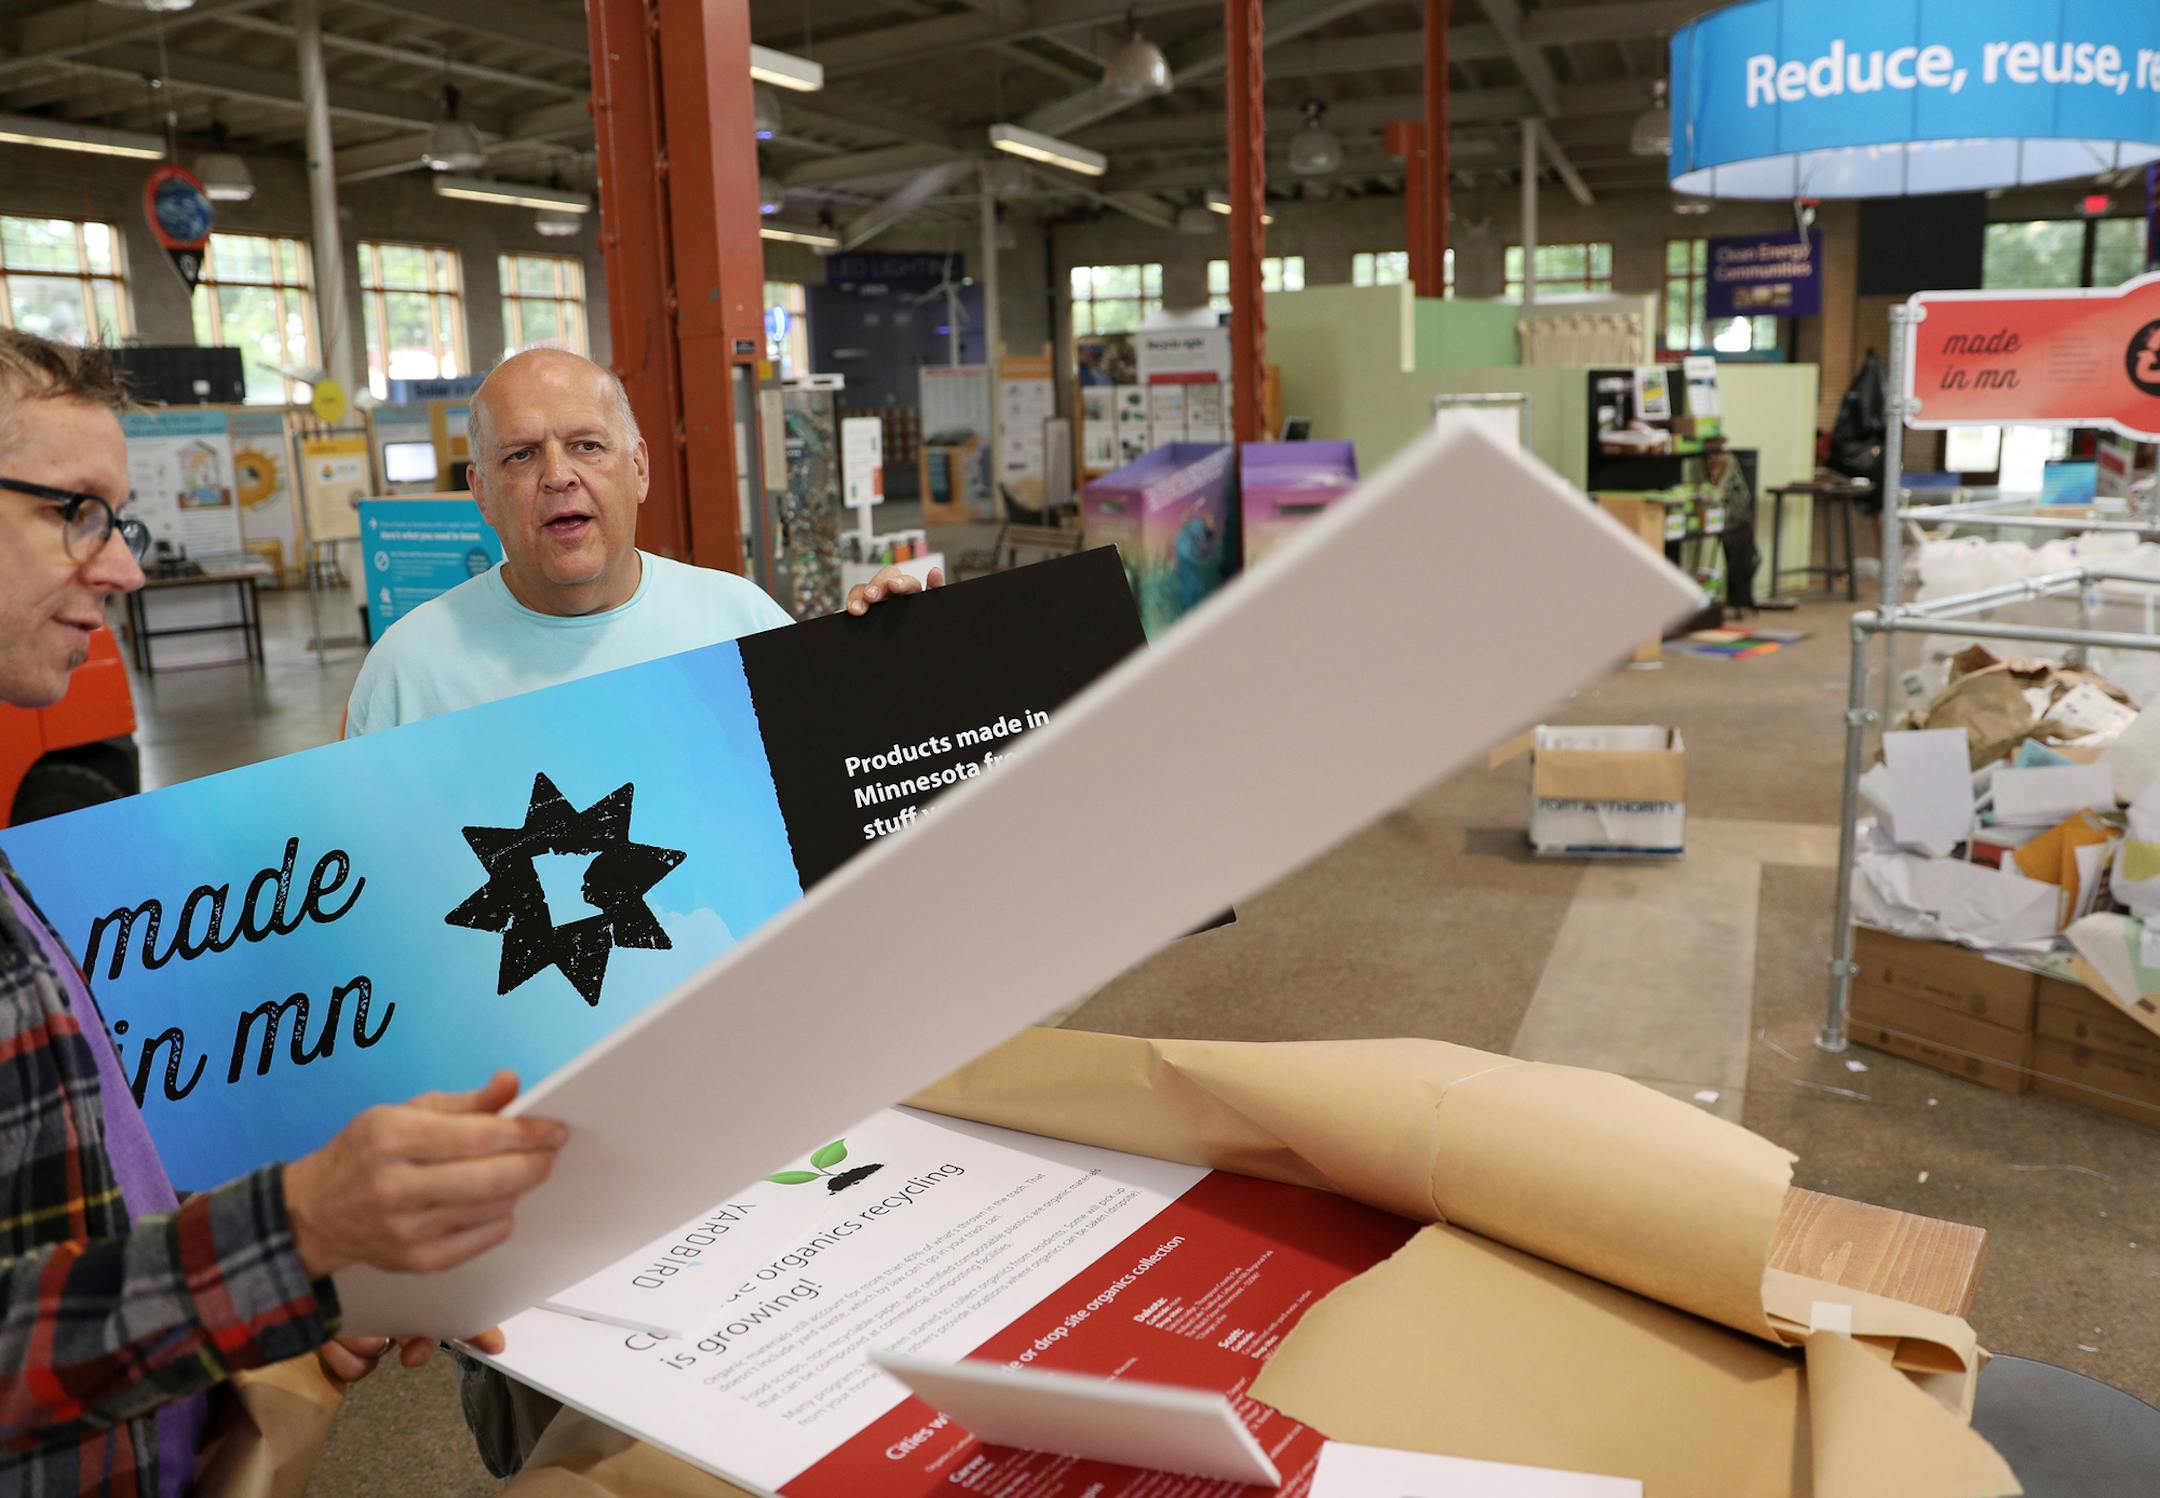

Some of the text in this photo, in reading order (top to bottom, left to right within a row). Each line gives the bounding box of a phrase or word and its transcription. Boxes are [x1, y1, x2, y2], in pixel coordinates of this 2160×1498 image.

[1747, 39, 1968, 108] Reduce,
[1983, 40, 2130, 95] reuse,
[1940, 365, 2020, 390] in mn
[1941, 328, 2022, 355] made
[845, 709, 1050, 777] Products made in
[853, 761, 981, 808] Minnesota
[863, 805, 917, 840] stuff
[83, 836, 366, 984] made
[227, 975, 396, 1084] mn
[632, 1203, 757, 1289] YARDBIRD
[756, 1163, 965, 1281] organics recycling
[703, 1361, 745, 1384] Organic
[745, 1333, 792, 1360] materials
[792, 1320, 811, 1332] still
[810, 1298, 847, 1321] account
[844, 1290, 863, 1299] for
[860, 1276, 885, 1290] more
[882, 1263, 906, 1276] than
[902, 1251, 924, 1263] 40%
[933, 1229, 959, 1245] what's
[956, 1211, 987, 1229] thrown
[992, 1198, 1008, 1206] the
[1026, 1173, 1047, 1184] That
[718, 1366, 760, 1391] doesn't
[757, 1345, 797, 1367] include
[796, 1330, 820, 1346] yard
[849, 1293, 879, 1311] which
[874, 1286, 893, 1294] by
[887, 1276, 907, 1286] law
[906, 1262, 928, 1276] can't
[947, 1237, 968, 1250] your
[963, 1224, 988, 1238] trash
[741, 1384, 771, 1402] Food
[904, 1288, 923, 1299] and
[922, 1266, 956, 1287] certified
[955, 1234, 1005, 1265] compostable
[1003, 1216, 1033, 1234] plastics
[1044, 1190, 1071, 1206] organic
[1069, 1169, 1102, 1189] materials
[1019, 1234, 1186, 1363] or drop site organics collection
[659, 1352, 697, 1370] is
[697, 1278, 823, 1355] growing!
[885, 1427, 934, 1460] Cities
